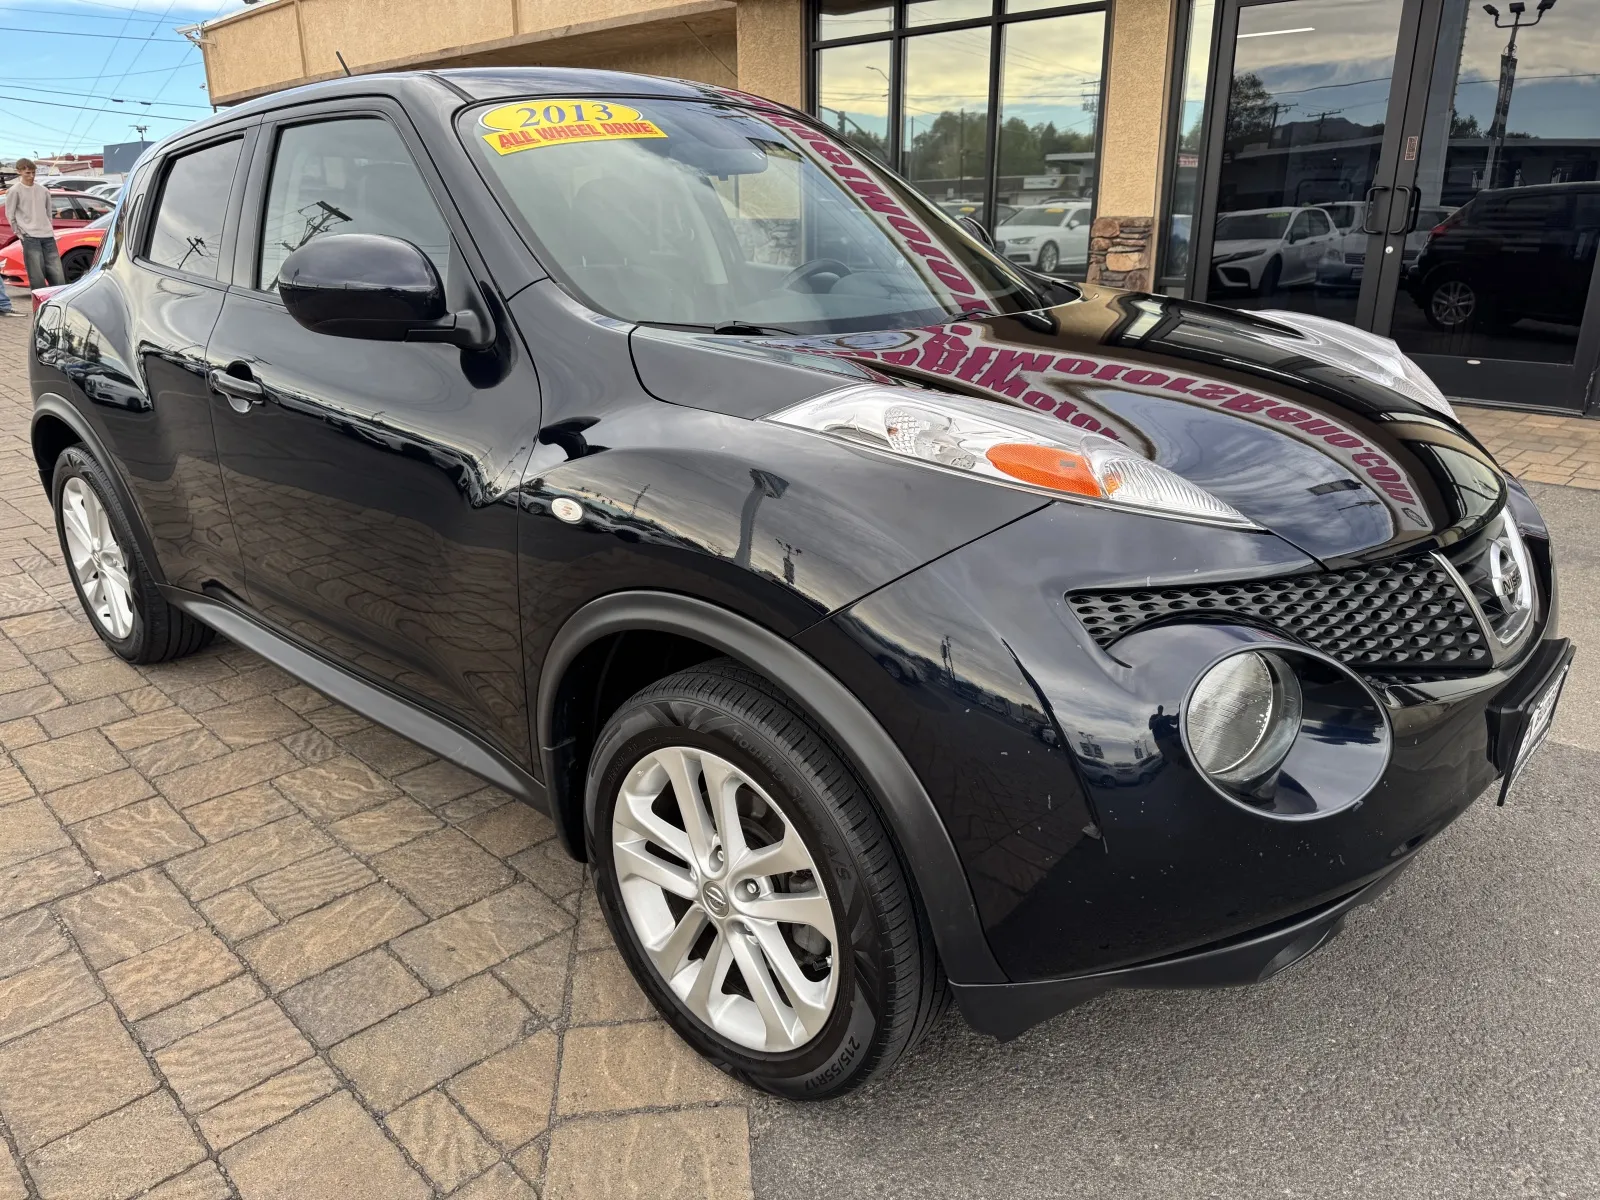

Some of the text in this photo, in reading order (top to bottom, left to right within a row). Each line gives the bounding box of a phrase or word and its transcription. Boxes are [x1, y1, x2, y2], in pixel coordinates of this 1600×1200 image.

[498, 122, 658, 149] ALL WHEEL DRIVE
[516, 104, 613, 127] 2013
[731, 729, 786, 782] Touring
[805, 1035, 860, 1091] 215/55R17
